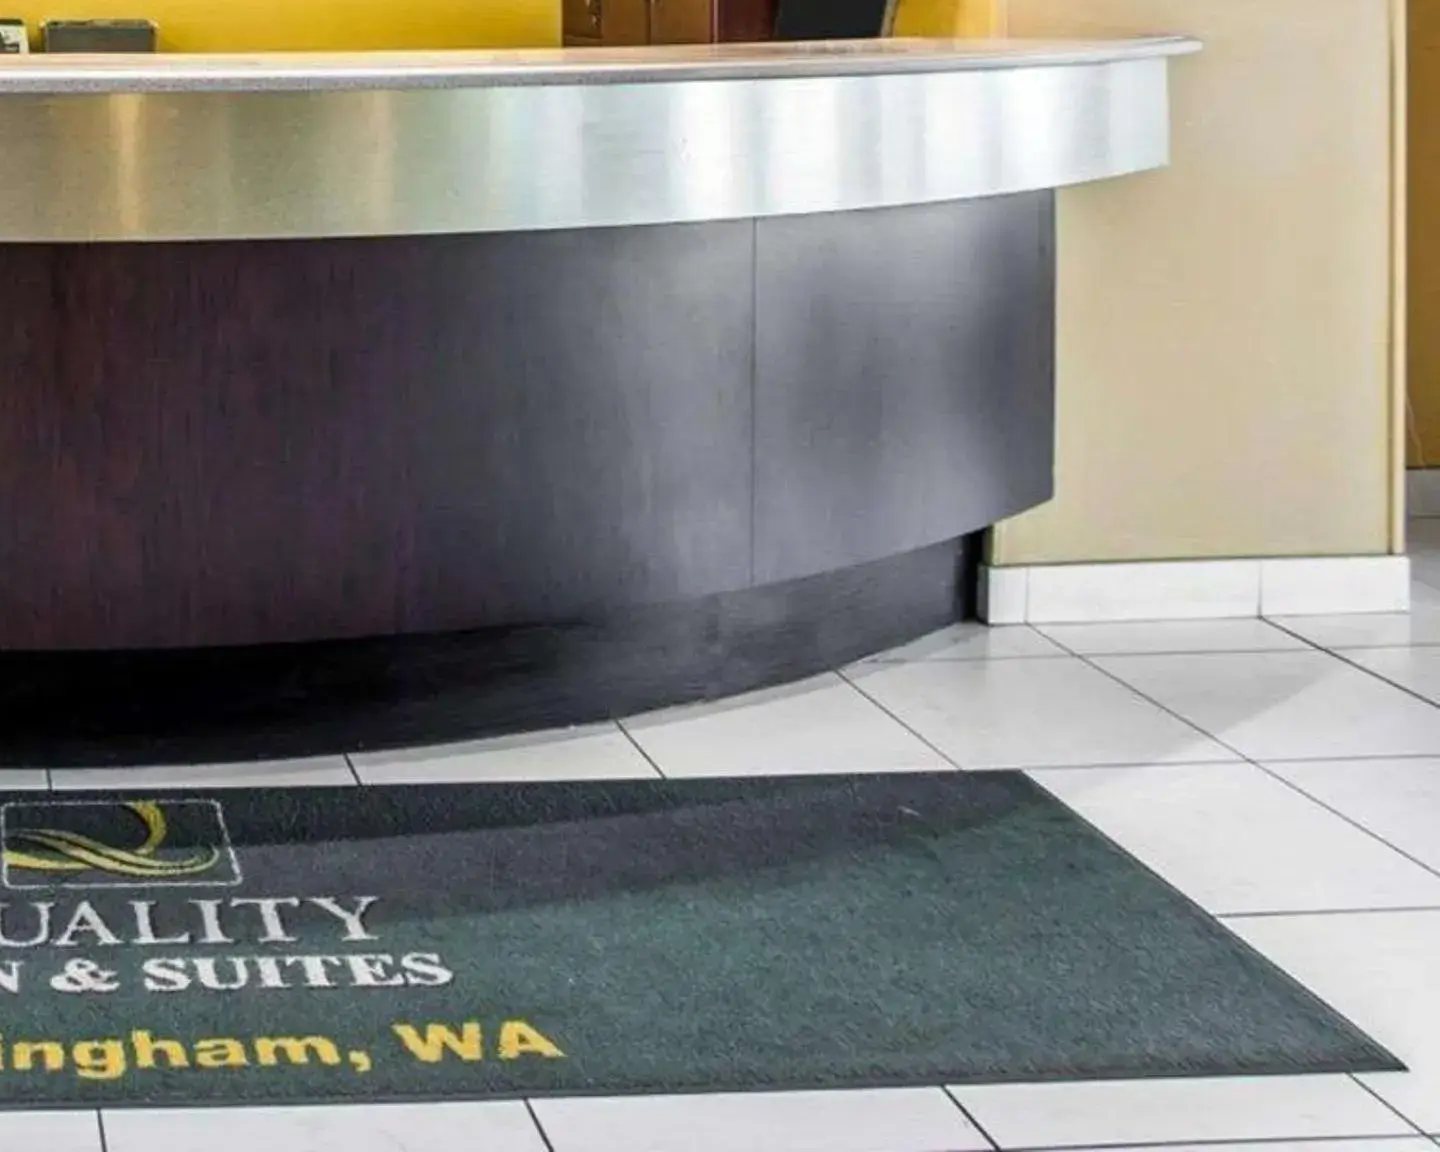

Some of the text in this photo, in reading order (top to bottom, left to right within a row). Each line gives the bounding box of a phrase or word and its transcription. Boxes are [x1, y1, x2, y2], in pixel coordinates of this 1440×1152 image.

[50, 958, 122, 993] &
[143, 951, 455, 991] SUITES
[393, 1020, 565, 1062] WA
